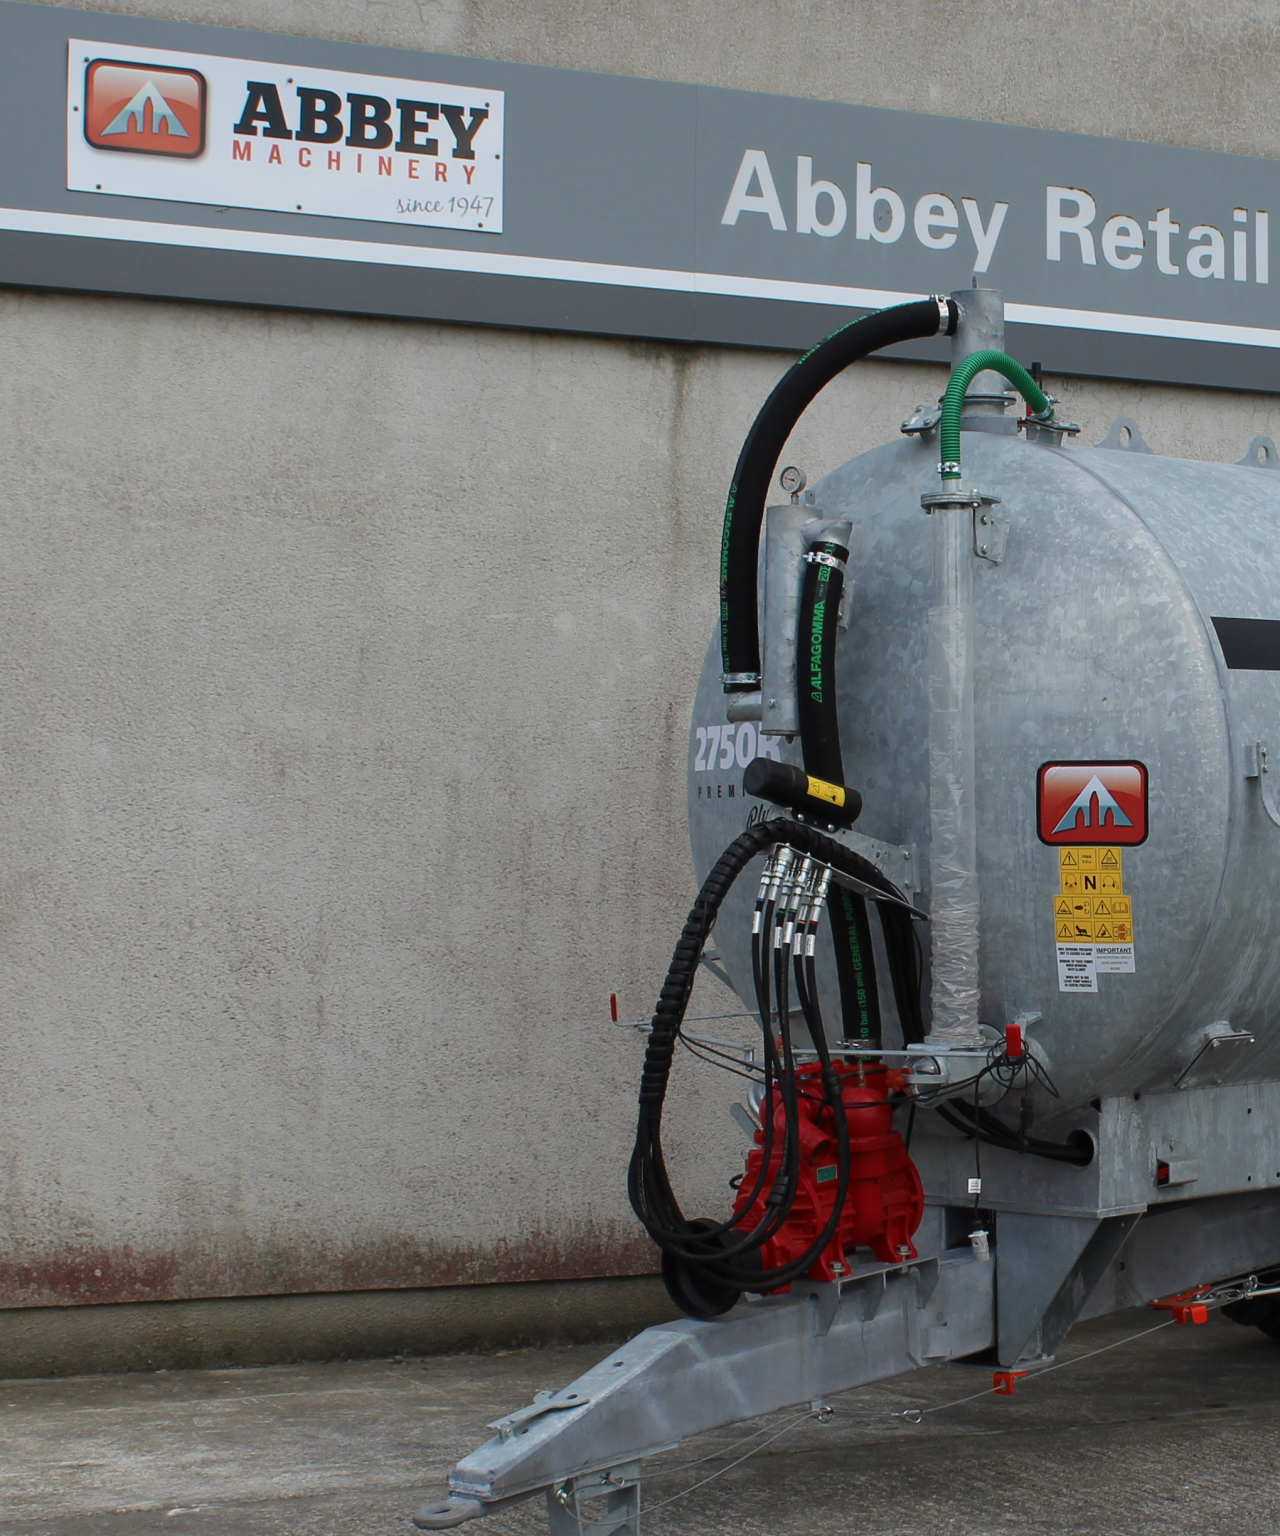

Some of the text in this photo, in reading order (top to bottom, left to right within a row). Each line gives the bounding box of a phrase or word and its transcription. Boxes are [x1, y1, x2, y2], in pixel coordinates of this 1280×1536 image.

[233, 80, 489, 160] ABBEY
[232, 140, 477, 185] MACHINERY
[396, 195, 494, 218] since 1947
[721, 149, 1269, 284] Abbey Retail
[811, 600, 826, 690] ALFAGOMMA
[697, 784, 747, 799] PREMI
[747, 804, 771, 830] Plu
[1084, 875, 1097, 890] N
[840, 884, 869, 1037] 10 bar (150 psi) GENERAL PURPO
